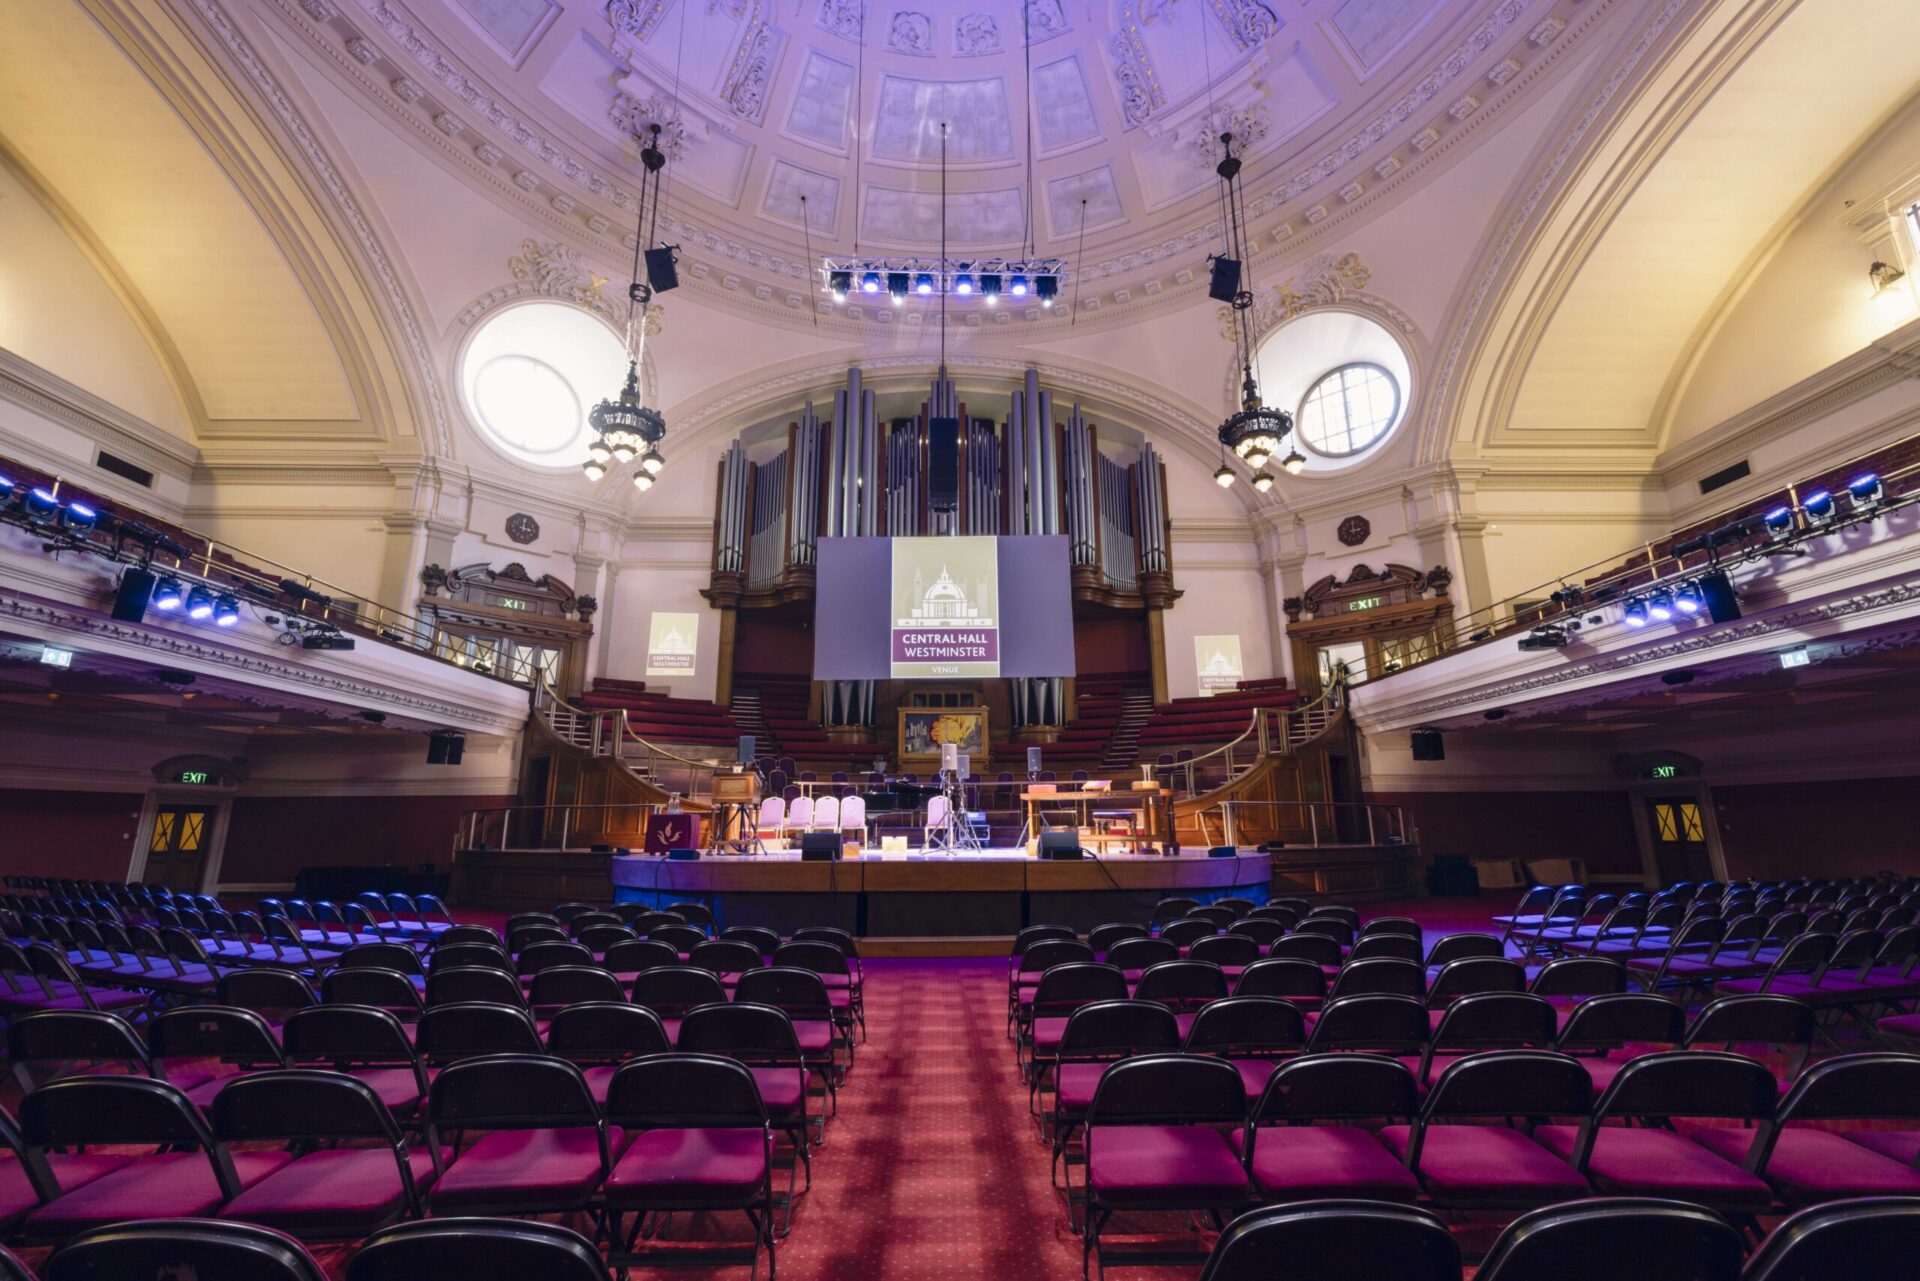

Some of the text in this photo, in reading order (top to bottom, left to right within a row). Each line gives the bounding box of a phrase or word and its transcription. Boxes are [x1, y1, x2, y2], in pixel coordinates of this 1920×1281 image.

[498, 598, 527, 610] XIT
[1349, 597, 1382, 611] EXIT
[902, 633, 988, 644] CENTRAL HALL
[904, 646, 987, 657] WESTMINSTER
[182, 772, 208, 783] EXIT
[1652, 766, 1675, 778] EXIT
